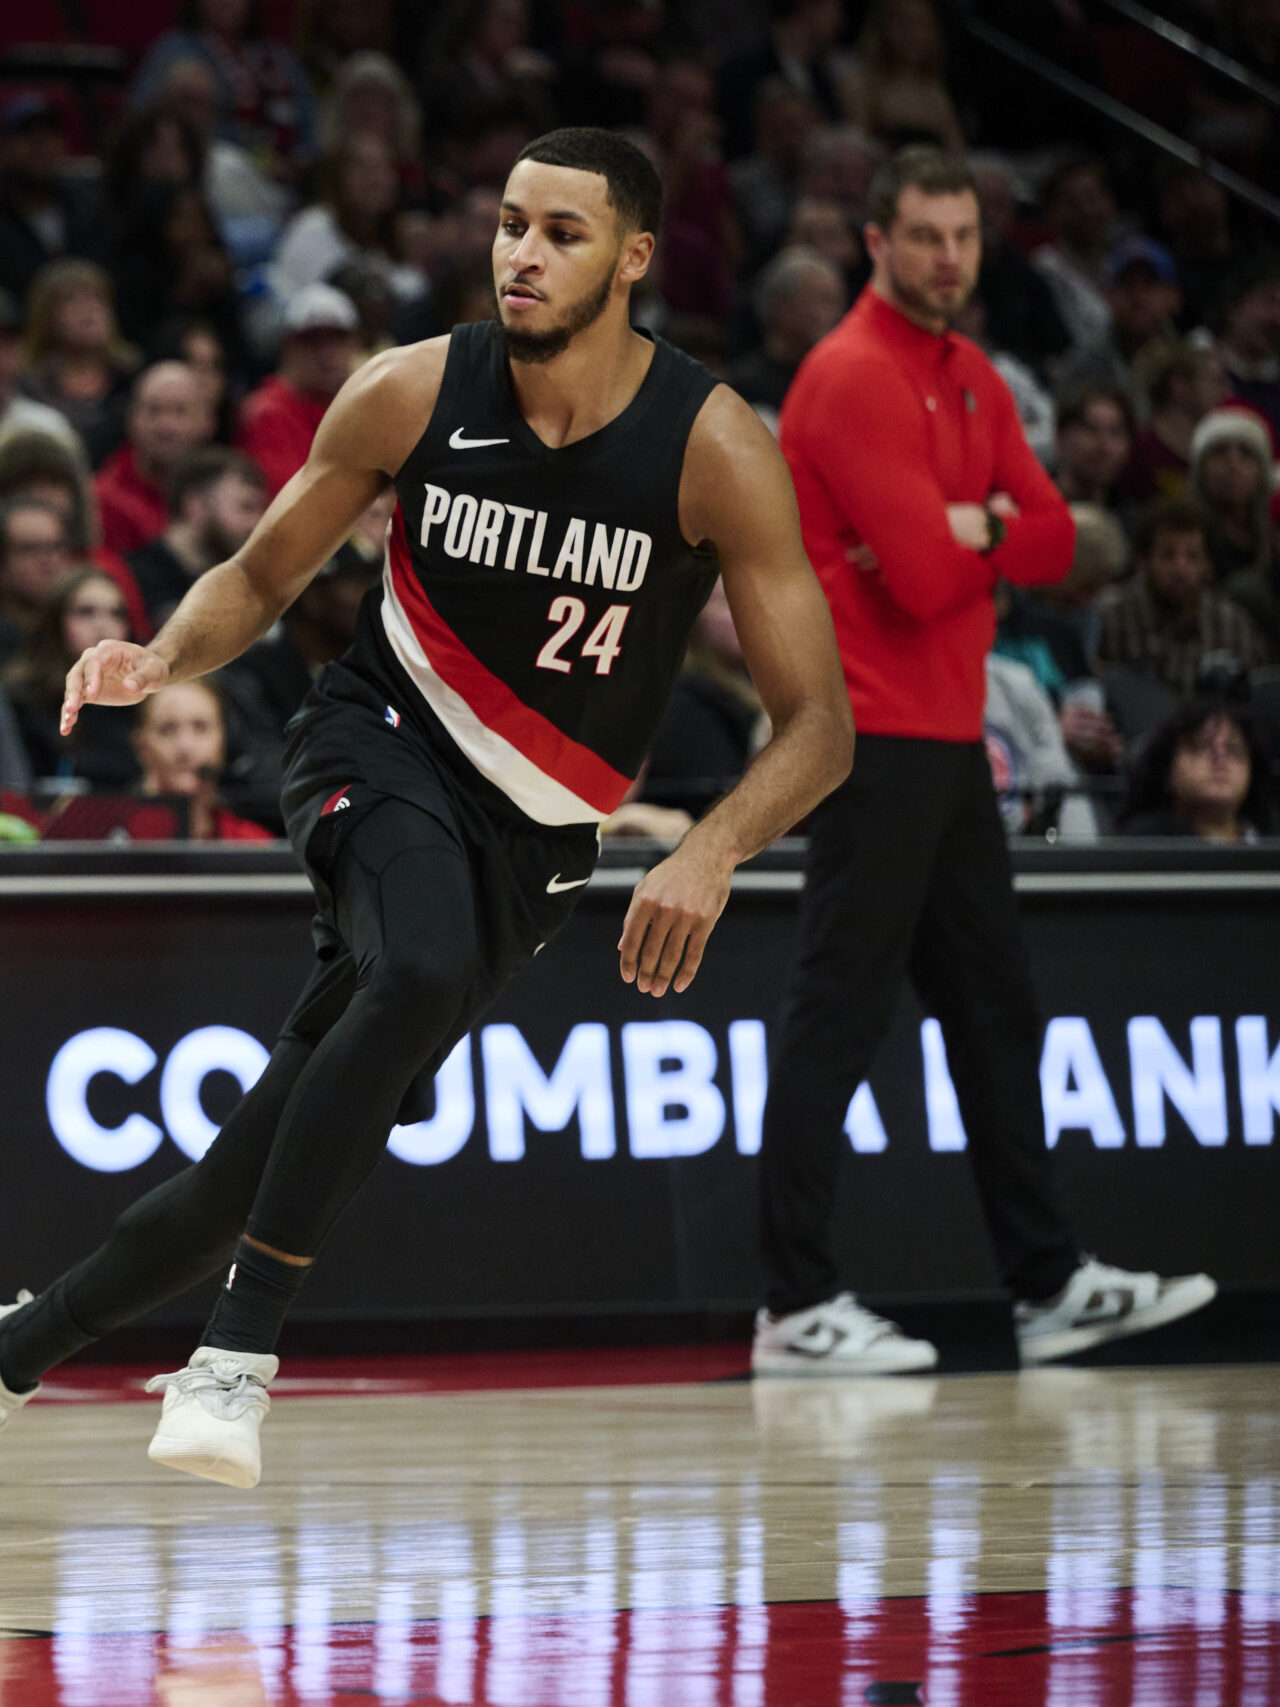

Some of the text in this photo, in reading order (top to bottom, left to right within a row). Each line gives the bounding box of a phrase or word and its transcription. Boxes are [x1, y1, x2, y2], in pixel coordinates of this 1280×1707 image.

[420, 483, 653, 592] PORTLAND
[535, 595, 631, 675] 24
[46, 1020, 888, 1173] COUMBI
